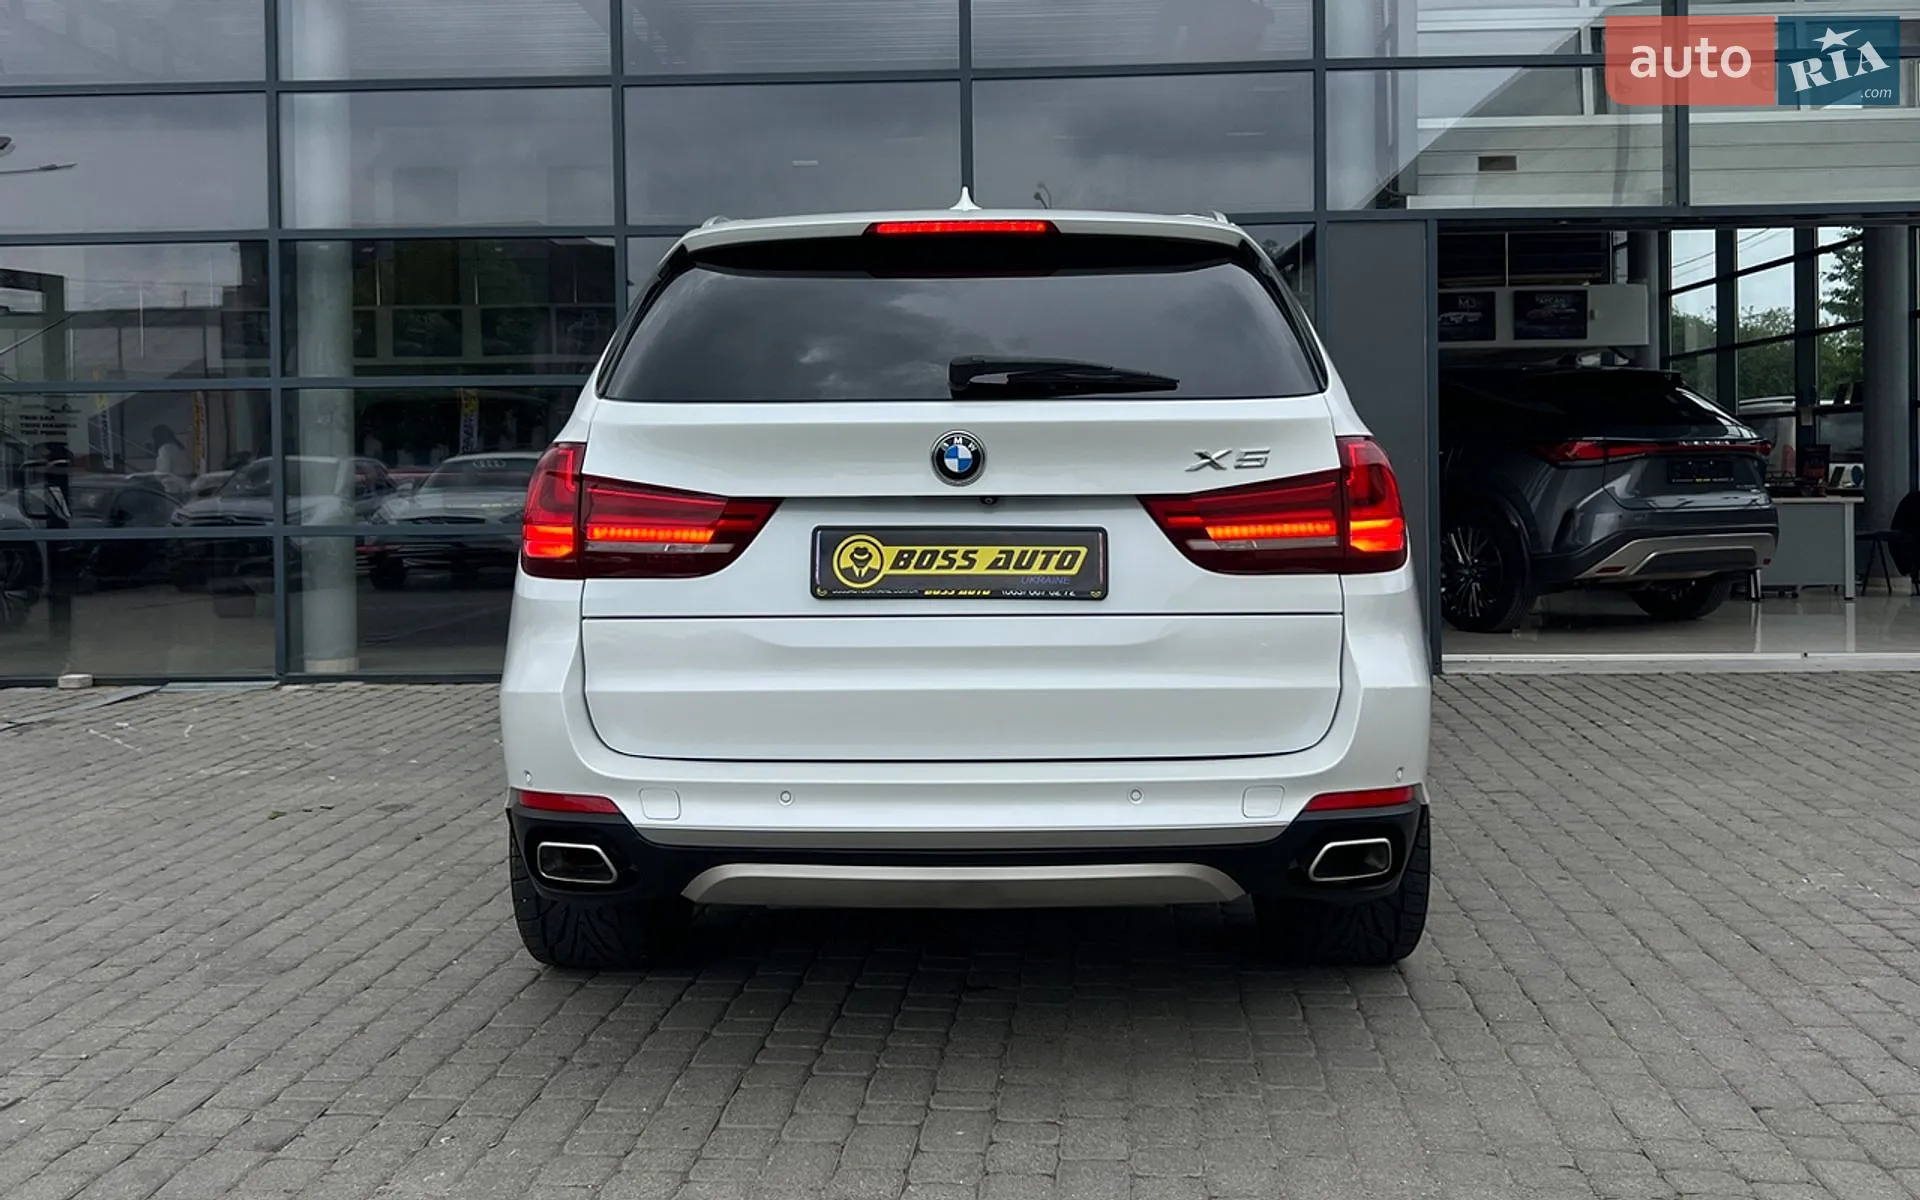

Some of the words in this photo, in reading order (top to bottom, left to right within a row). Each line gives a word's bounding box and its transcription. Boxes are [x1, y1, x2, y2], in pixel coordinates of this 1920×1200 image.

[1184, 448, 1271, 472] X5
[889, 549, 979, 570] BOSS
[985, 549, 1083, 570] AUTO
[1020, 576, 1071, 585] UKRAINE
